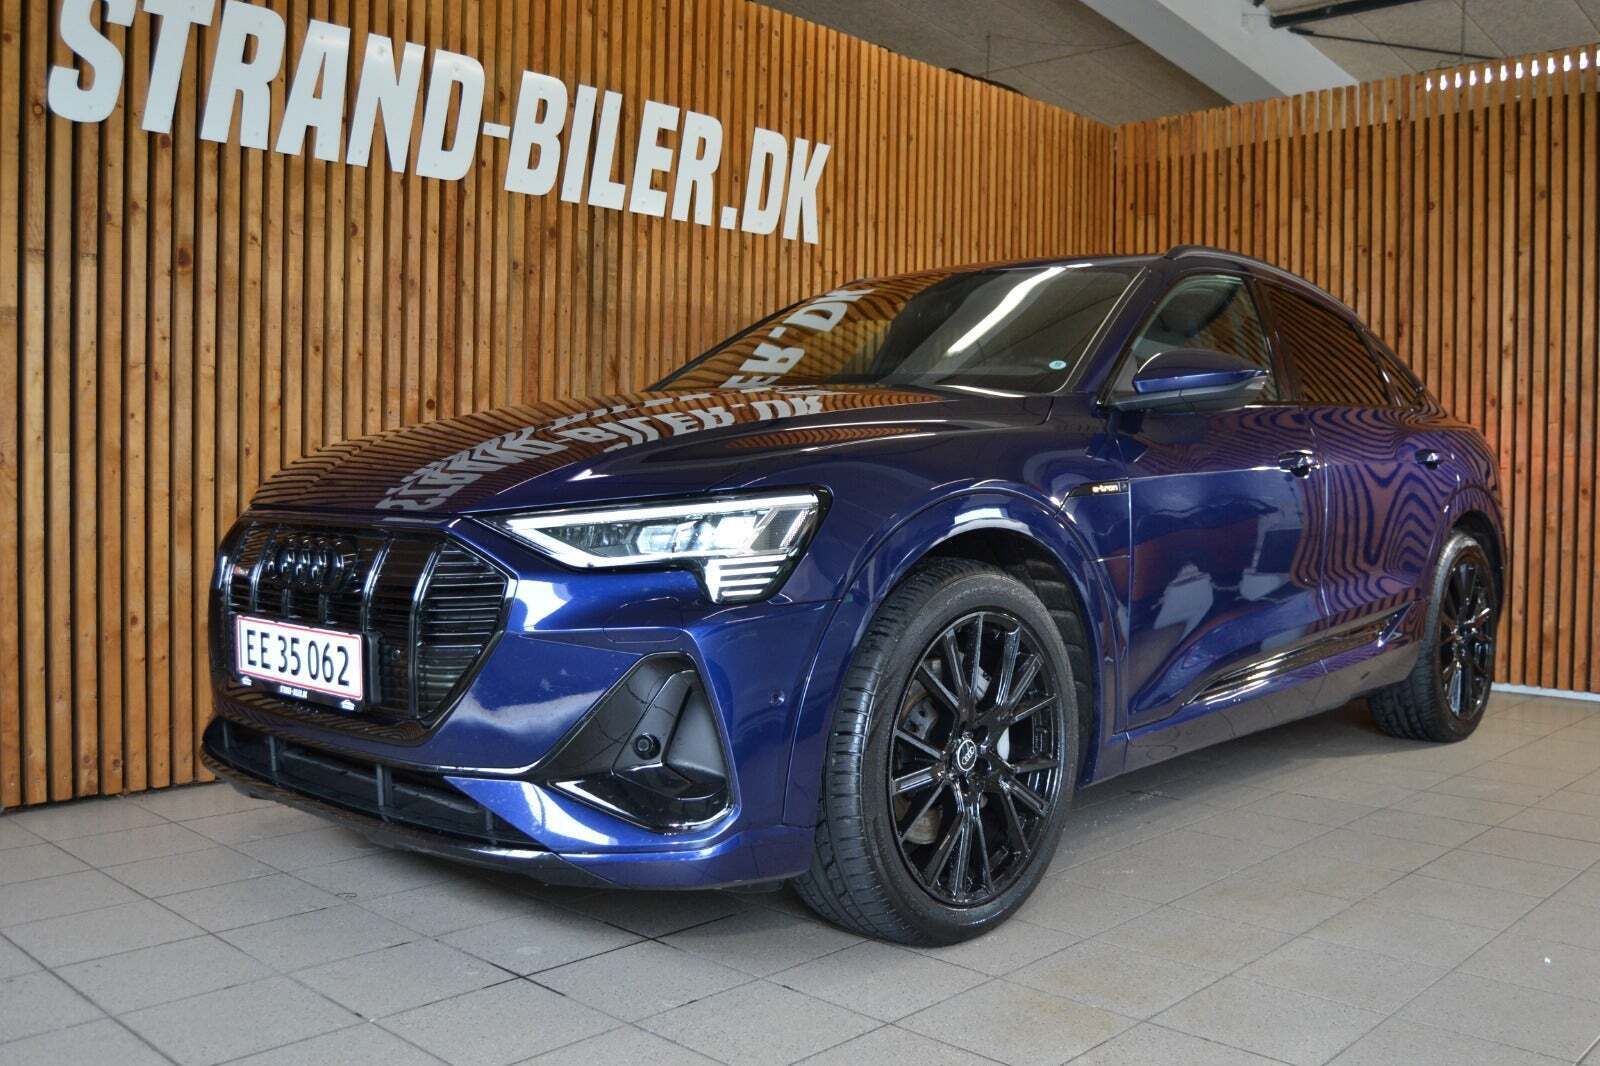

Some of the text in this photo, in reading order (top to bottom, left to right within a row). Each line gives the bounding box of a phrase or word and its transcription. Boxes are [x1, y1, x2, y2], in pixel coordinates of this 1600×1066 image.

[48, 0, 830, 245] STRAND-BILER.DK
[1092, 484, 1119, 493] e-tron
[246, 629, 350, 687] EE 35 062
